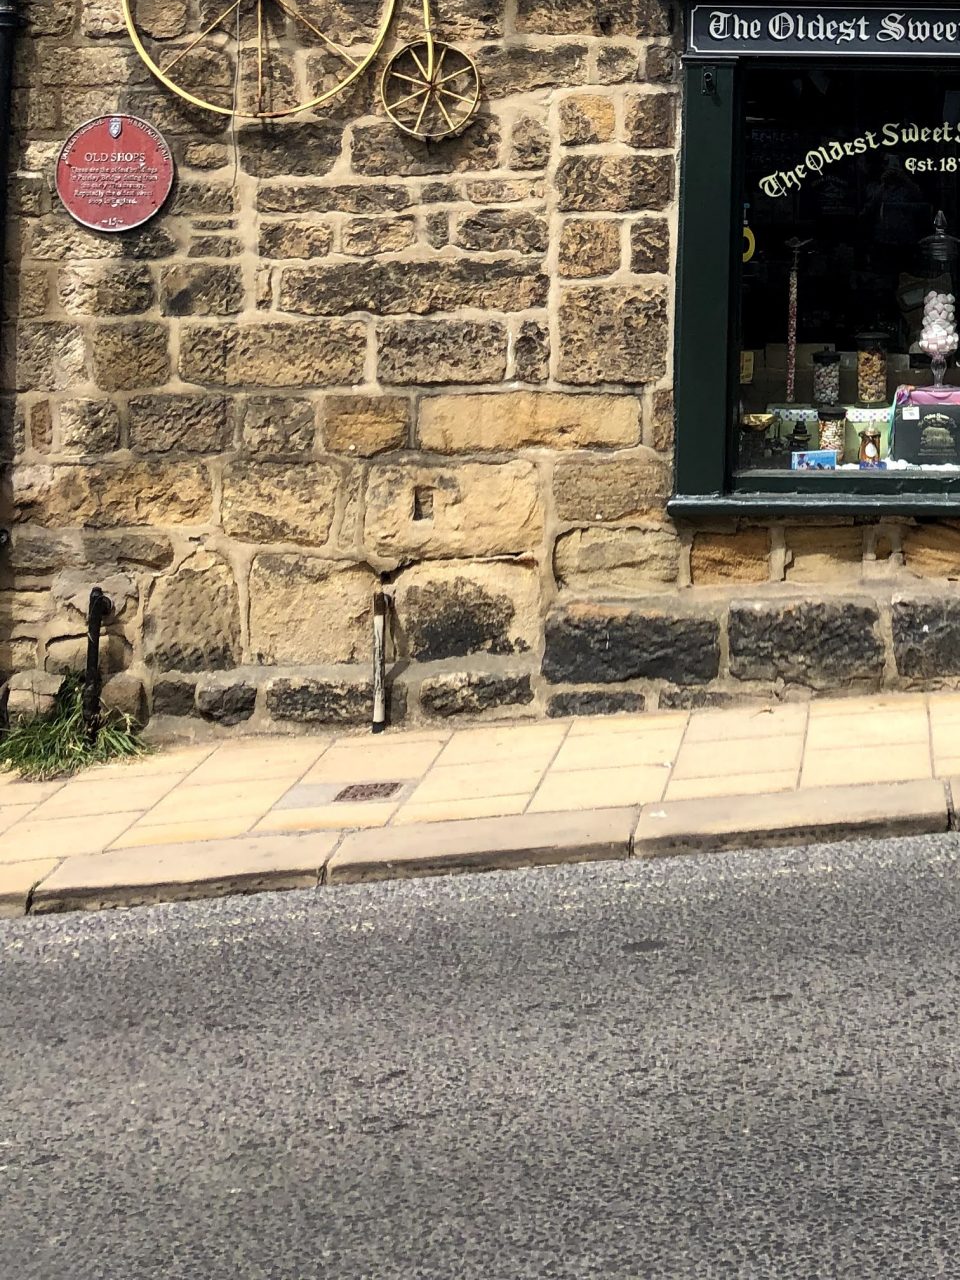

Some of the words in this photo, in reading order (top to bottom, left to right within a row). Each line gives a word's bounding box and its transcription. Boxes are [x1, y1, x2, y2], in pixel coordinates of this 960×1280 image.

[708, 11, 761, 40] The
[768, 12, 870, 45] Oldest
[84, 152, 109, 162] OLD
[110, 152, 146, 162] SHOPS
[758, 164, 808, 198] The
[805, 130, 880, 176] Oldest
[881, 121, 953, 147] Sweet
